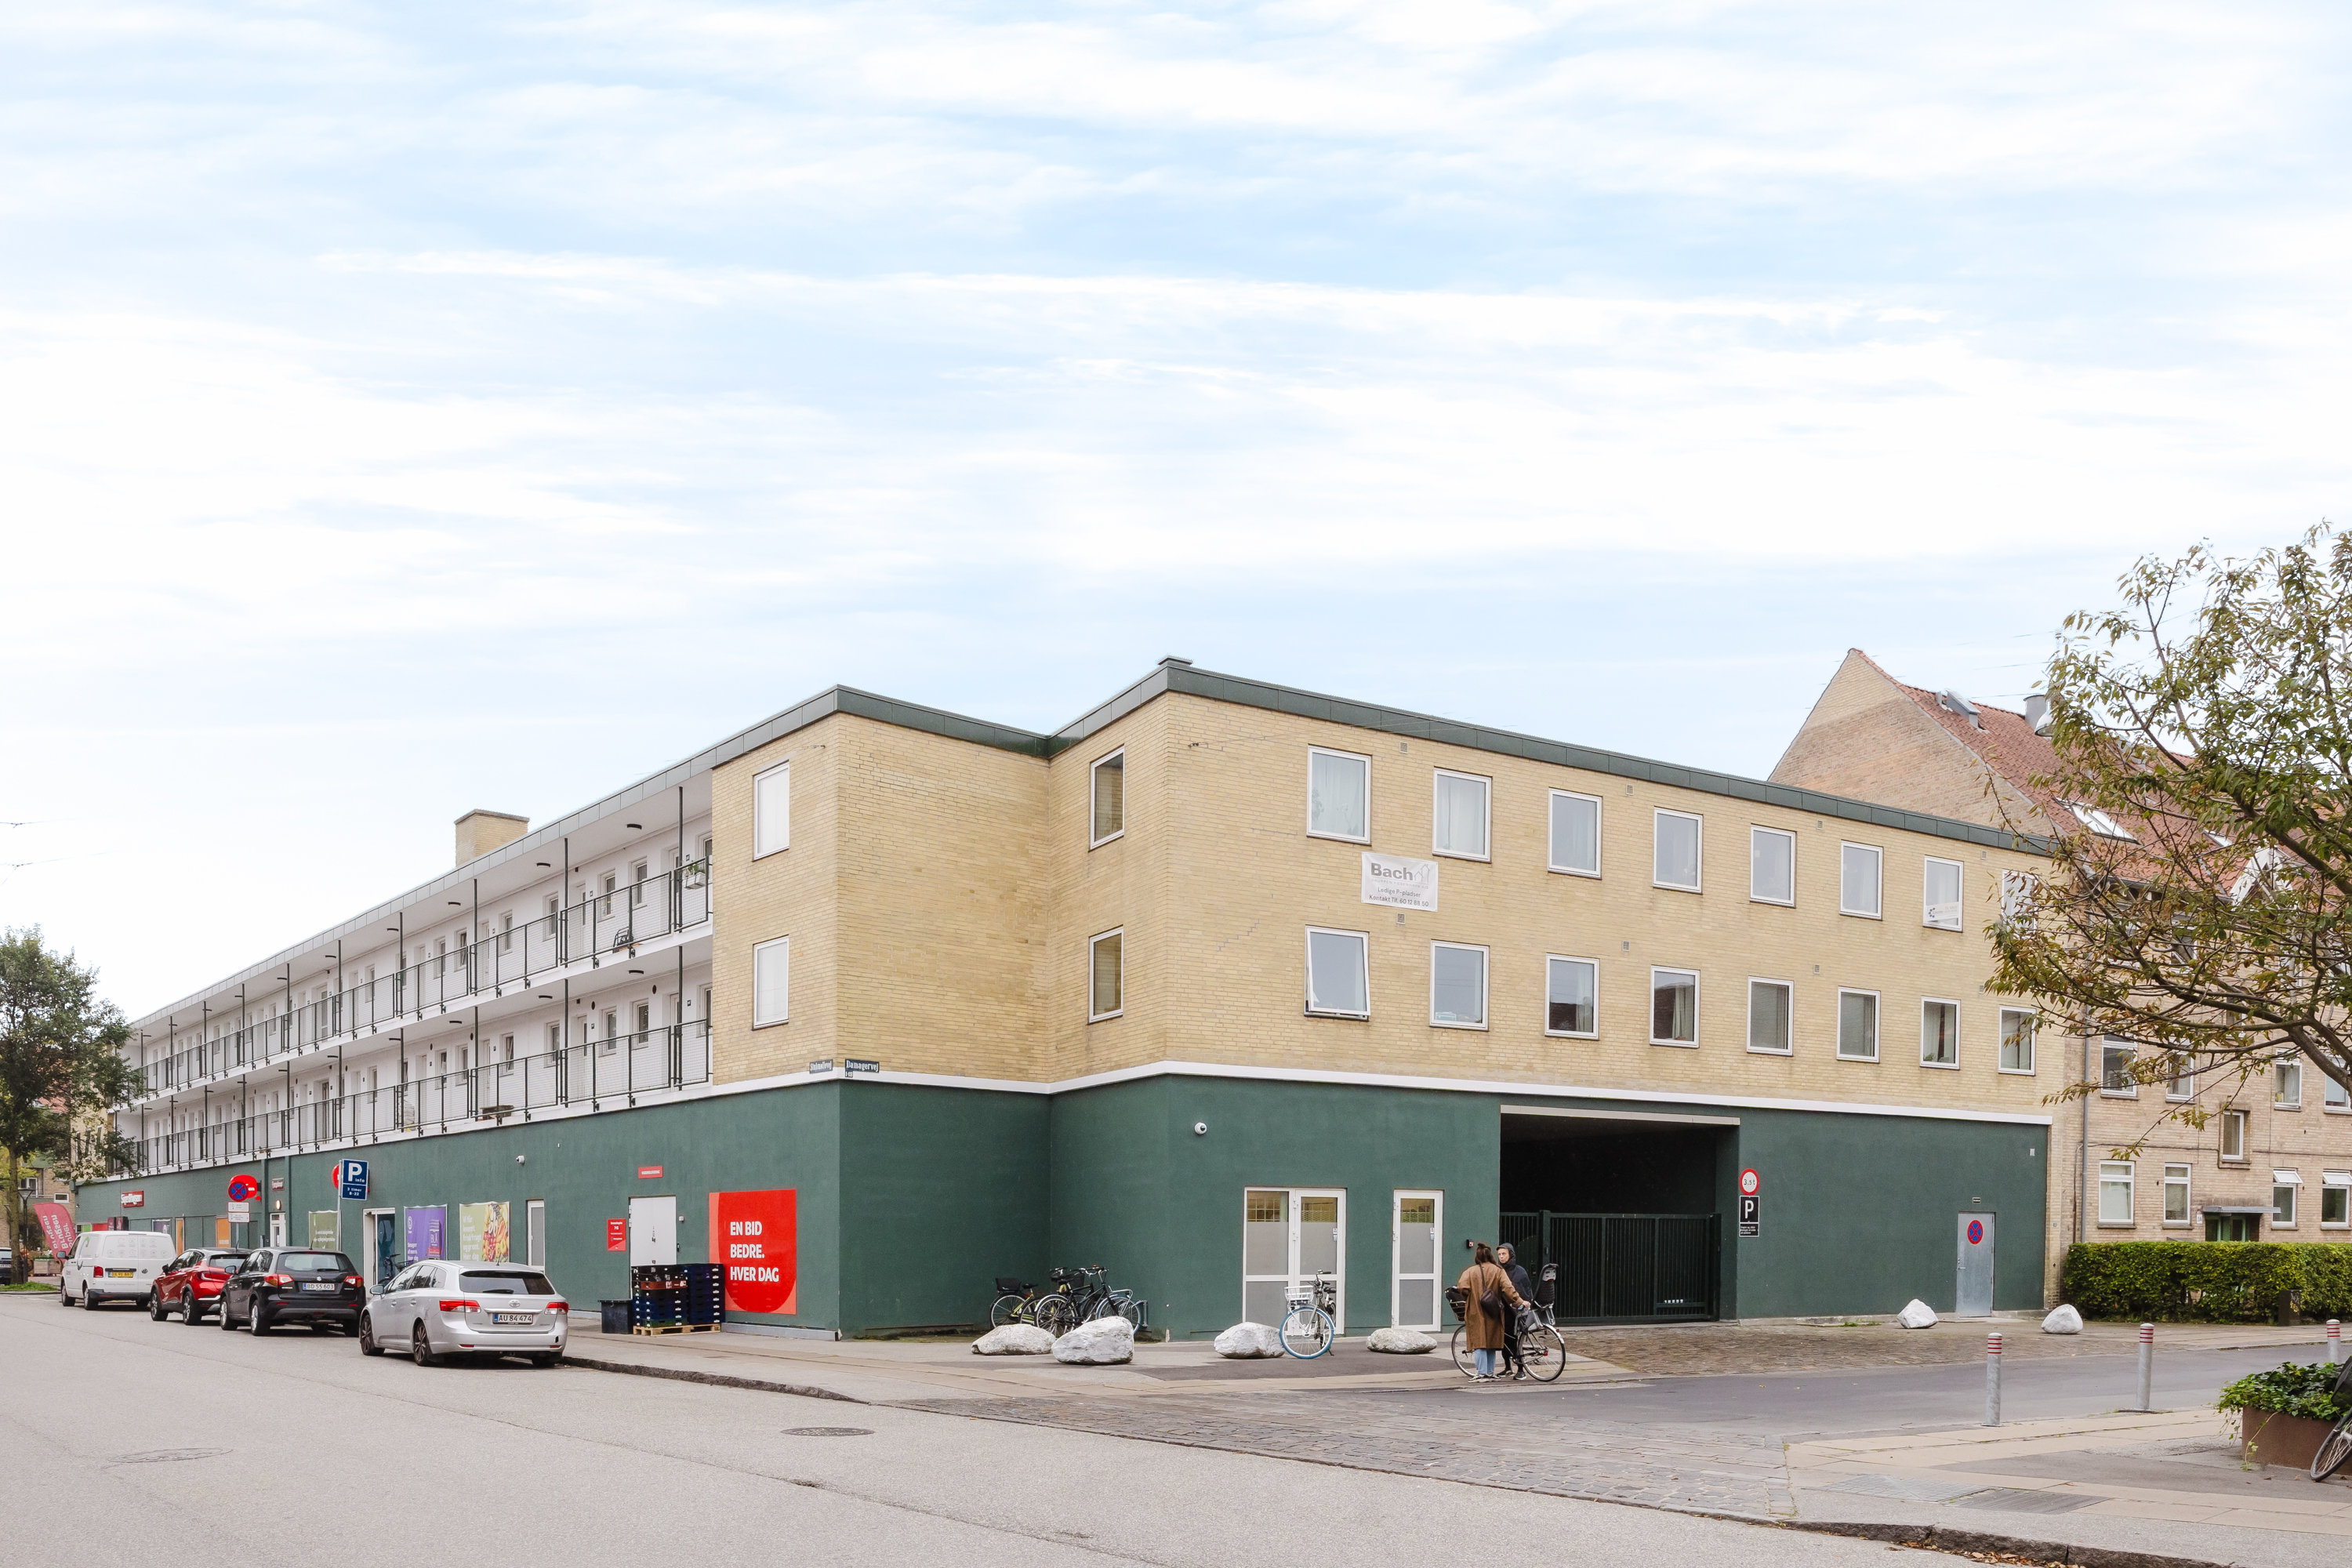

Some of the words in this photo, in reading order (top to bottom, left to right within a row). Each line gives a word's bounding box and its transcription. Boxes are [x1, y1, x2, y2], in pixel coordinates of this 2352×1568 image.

[1370, 862, 1414, 880] Bach
[1378, 887, 1395, 895] Ledige
[1396, 889, 1421, 898] P-pladser
[846, 1059, 879, 1073] Damagervej
[348, 1163, 362, 1181] P
[1744, 1200, 1755, 1219] P
[730, 1221, 743, 1236] EN
[745, 1221, 763, 1236] BID
[730, 1243, 765, 1258] BEDRE.
[730, 1266, 757, 1281] HVER
[757, 1267, 779, 1282] DAG
